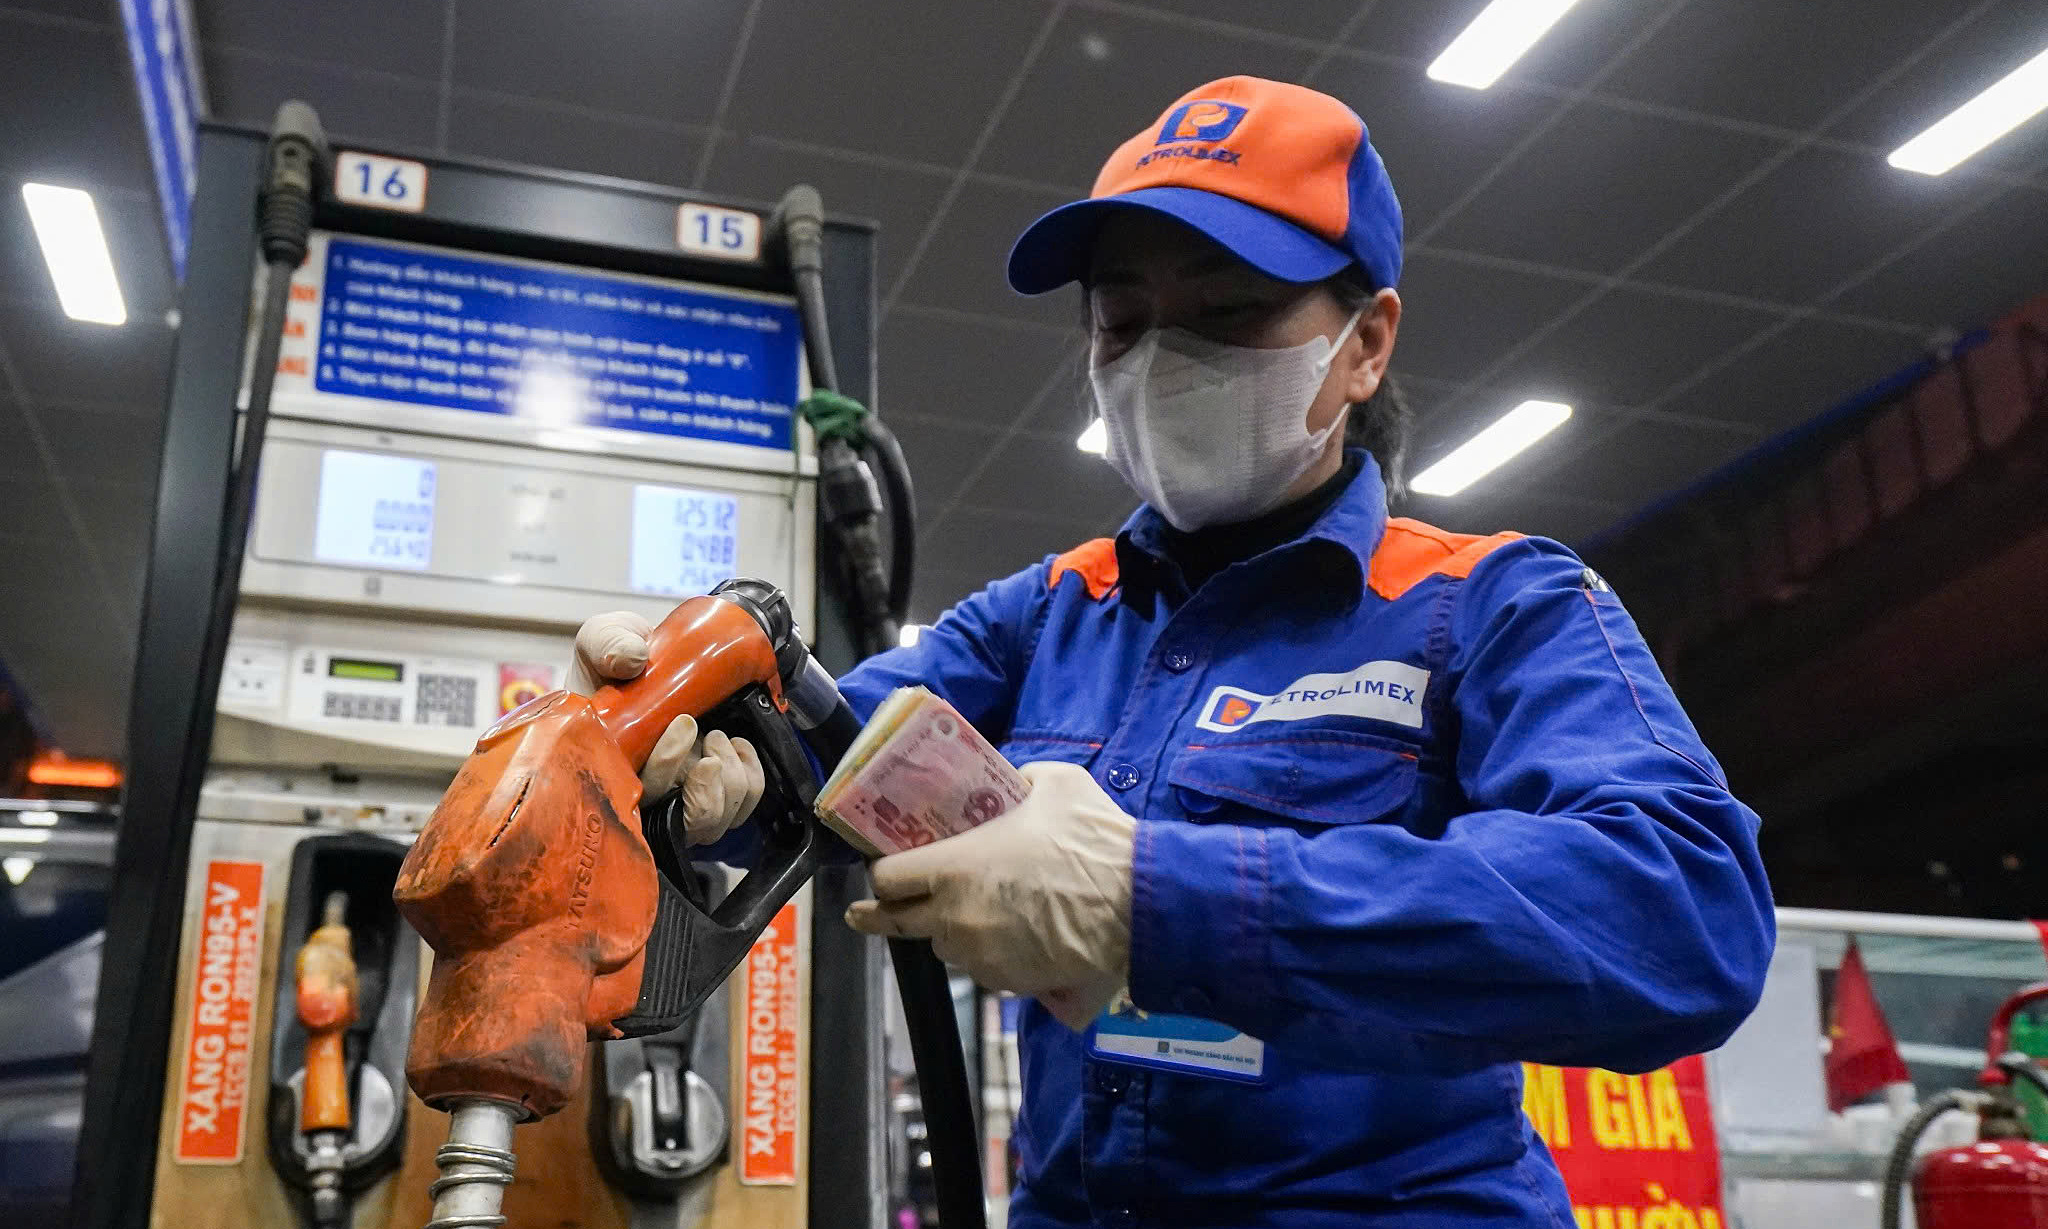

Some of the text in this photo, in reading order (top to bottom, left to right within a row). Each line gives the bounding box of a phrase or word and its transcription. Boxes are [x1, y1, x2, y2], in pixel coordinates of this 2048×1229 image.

[1135, 146, 1242, 170] PETROLIMEX
[354, 161, 408, 200] 16
[693, 213, 744, 250] 15
[1271, 680, 1416, 706] ETROLIMEX
[200, 881, 241, 1027] RON95-V
